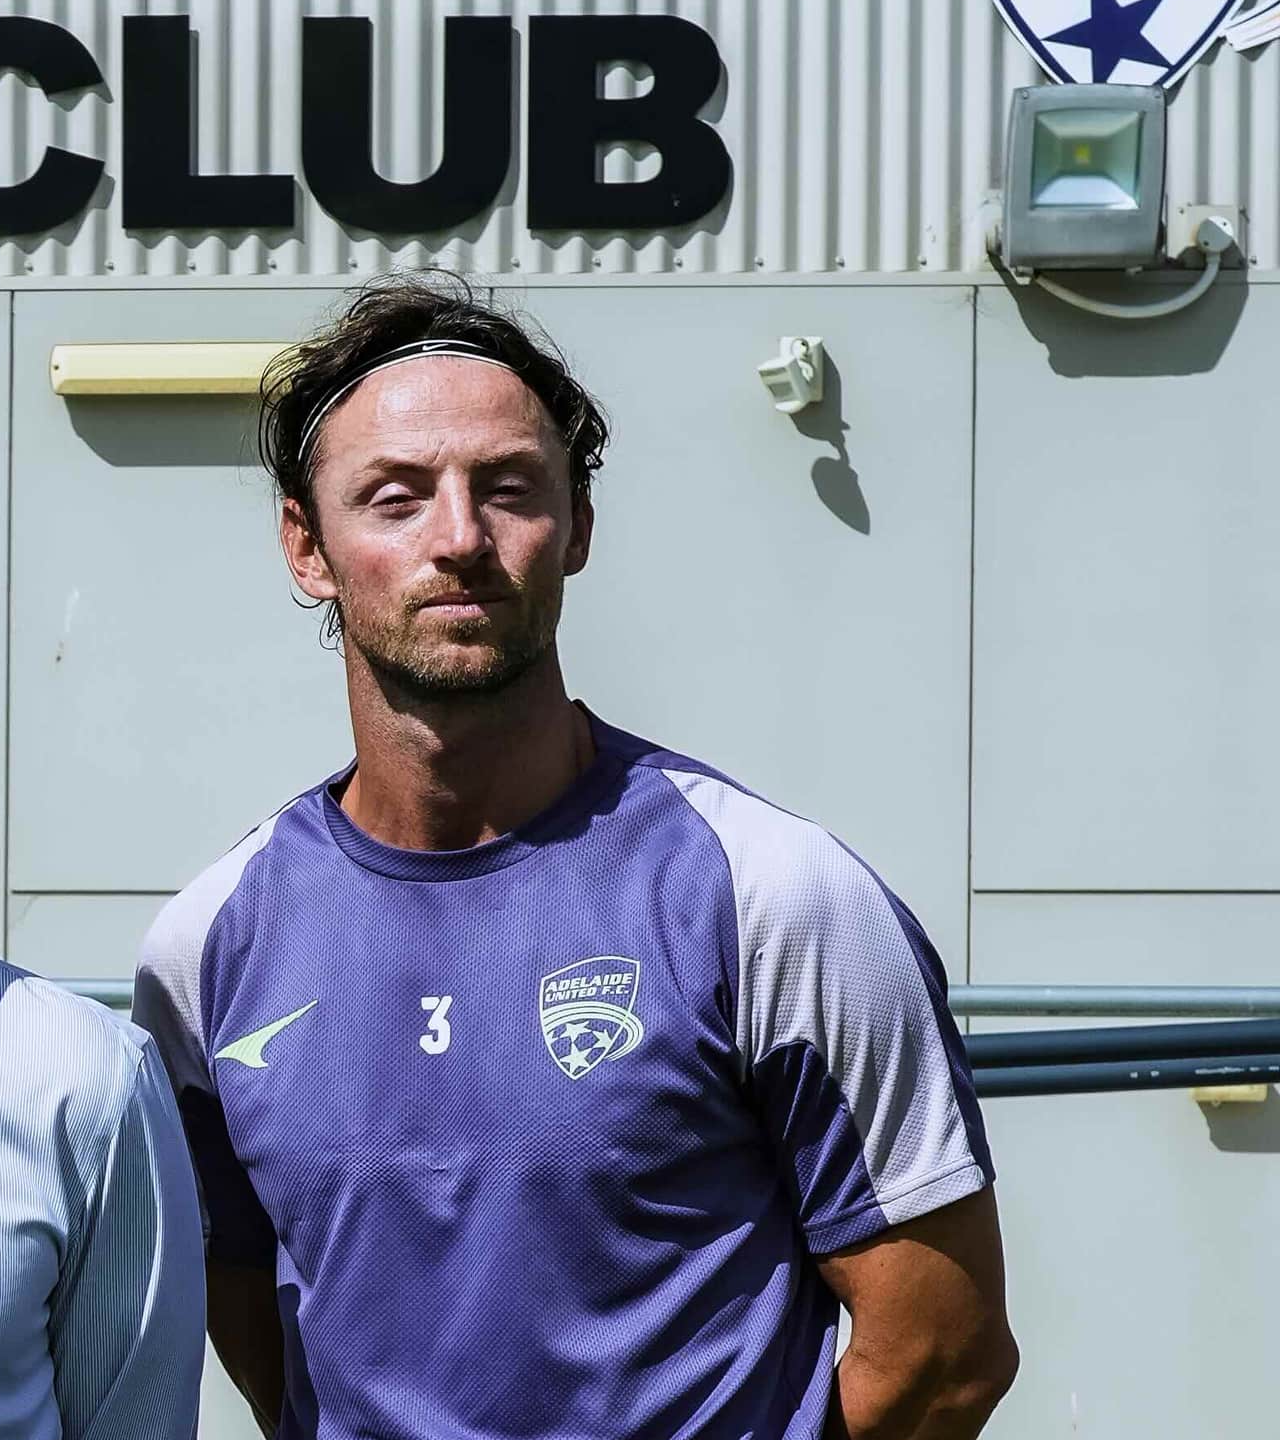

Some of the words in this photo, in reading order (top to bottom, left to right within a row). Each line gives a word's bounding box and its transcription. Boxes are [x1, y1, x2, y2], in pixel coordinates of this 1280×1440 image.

[545, 973, 633, 992] ADELAIDE
[545, 987, 597, 1002] UNITED
[601, 985, 629, 995] F.C.
[420, 995, 453, 1054] 3
